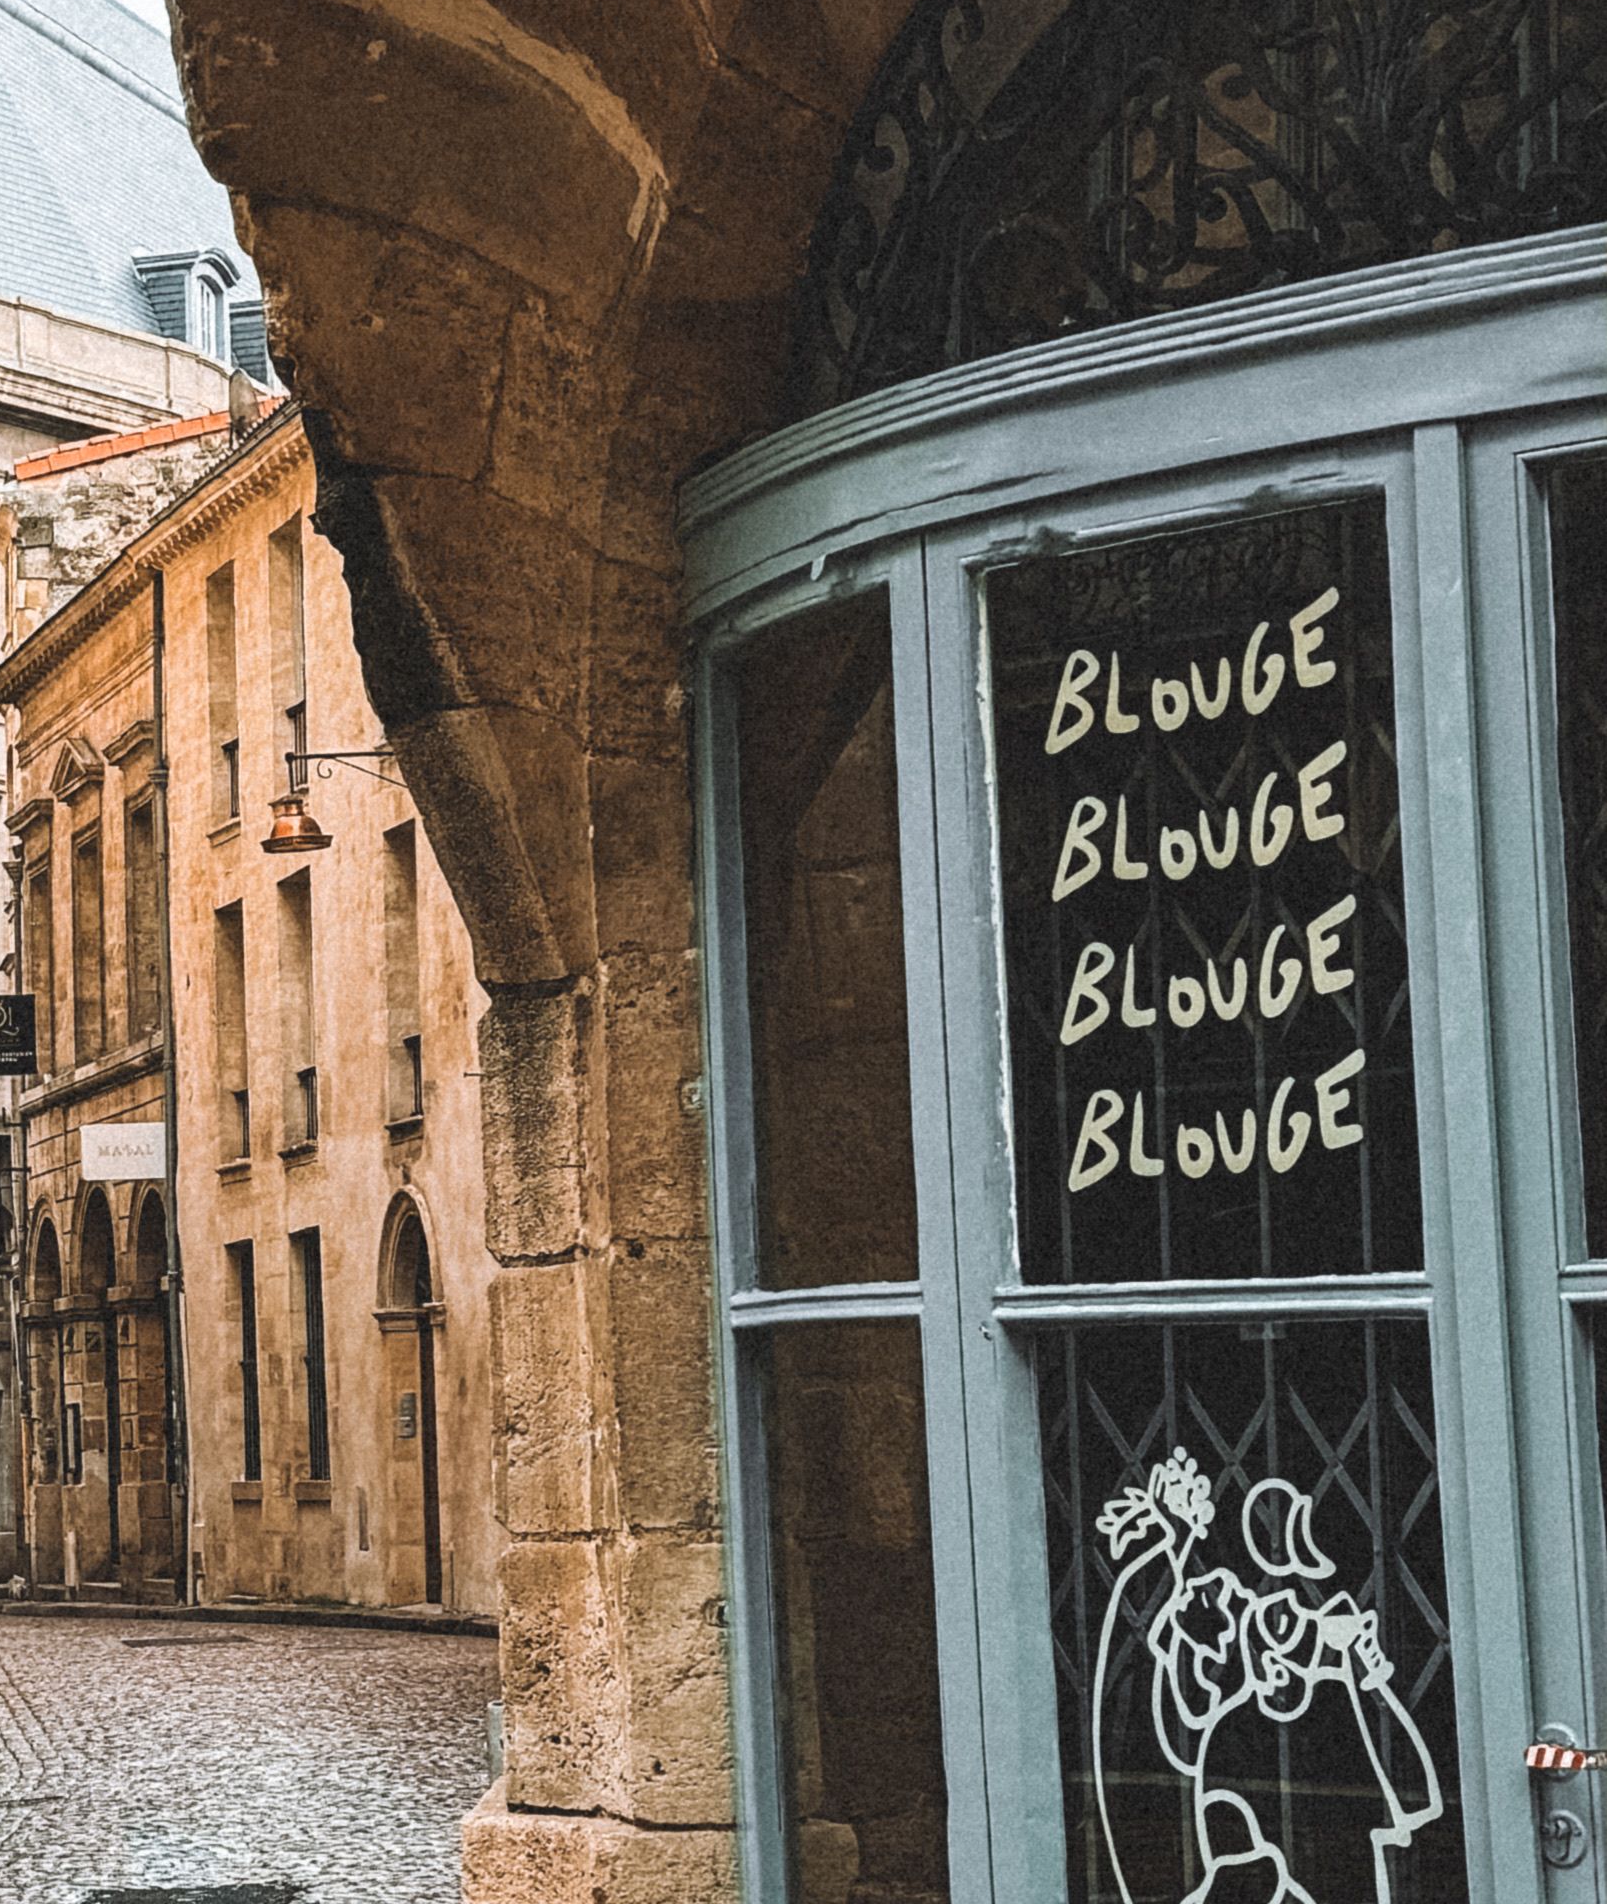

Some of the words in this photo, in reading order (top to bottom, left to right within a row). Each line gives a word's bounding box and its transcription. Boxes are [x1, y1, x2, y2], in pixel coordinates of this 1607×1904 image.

[1045, 586, 1339, 754] BLOUGE
[1052, 740, 1347, 902] BLOUGE
[1060, 894, 1356, 1046] BLOUGE
[1068, 1048, 1365, 1192] BLOUGE
